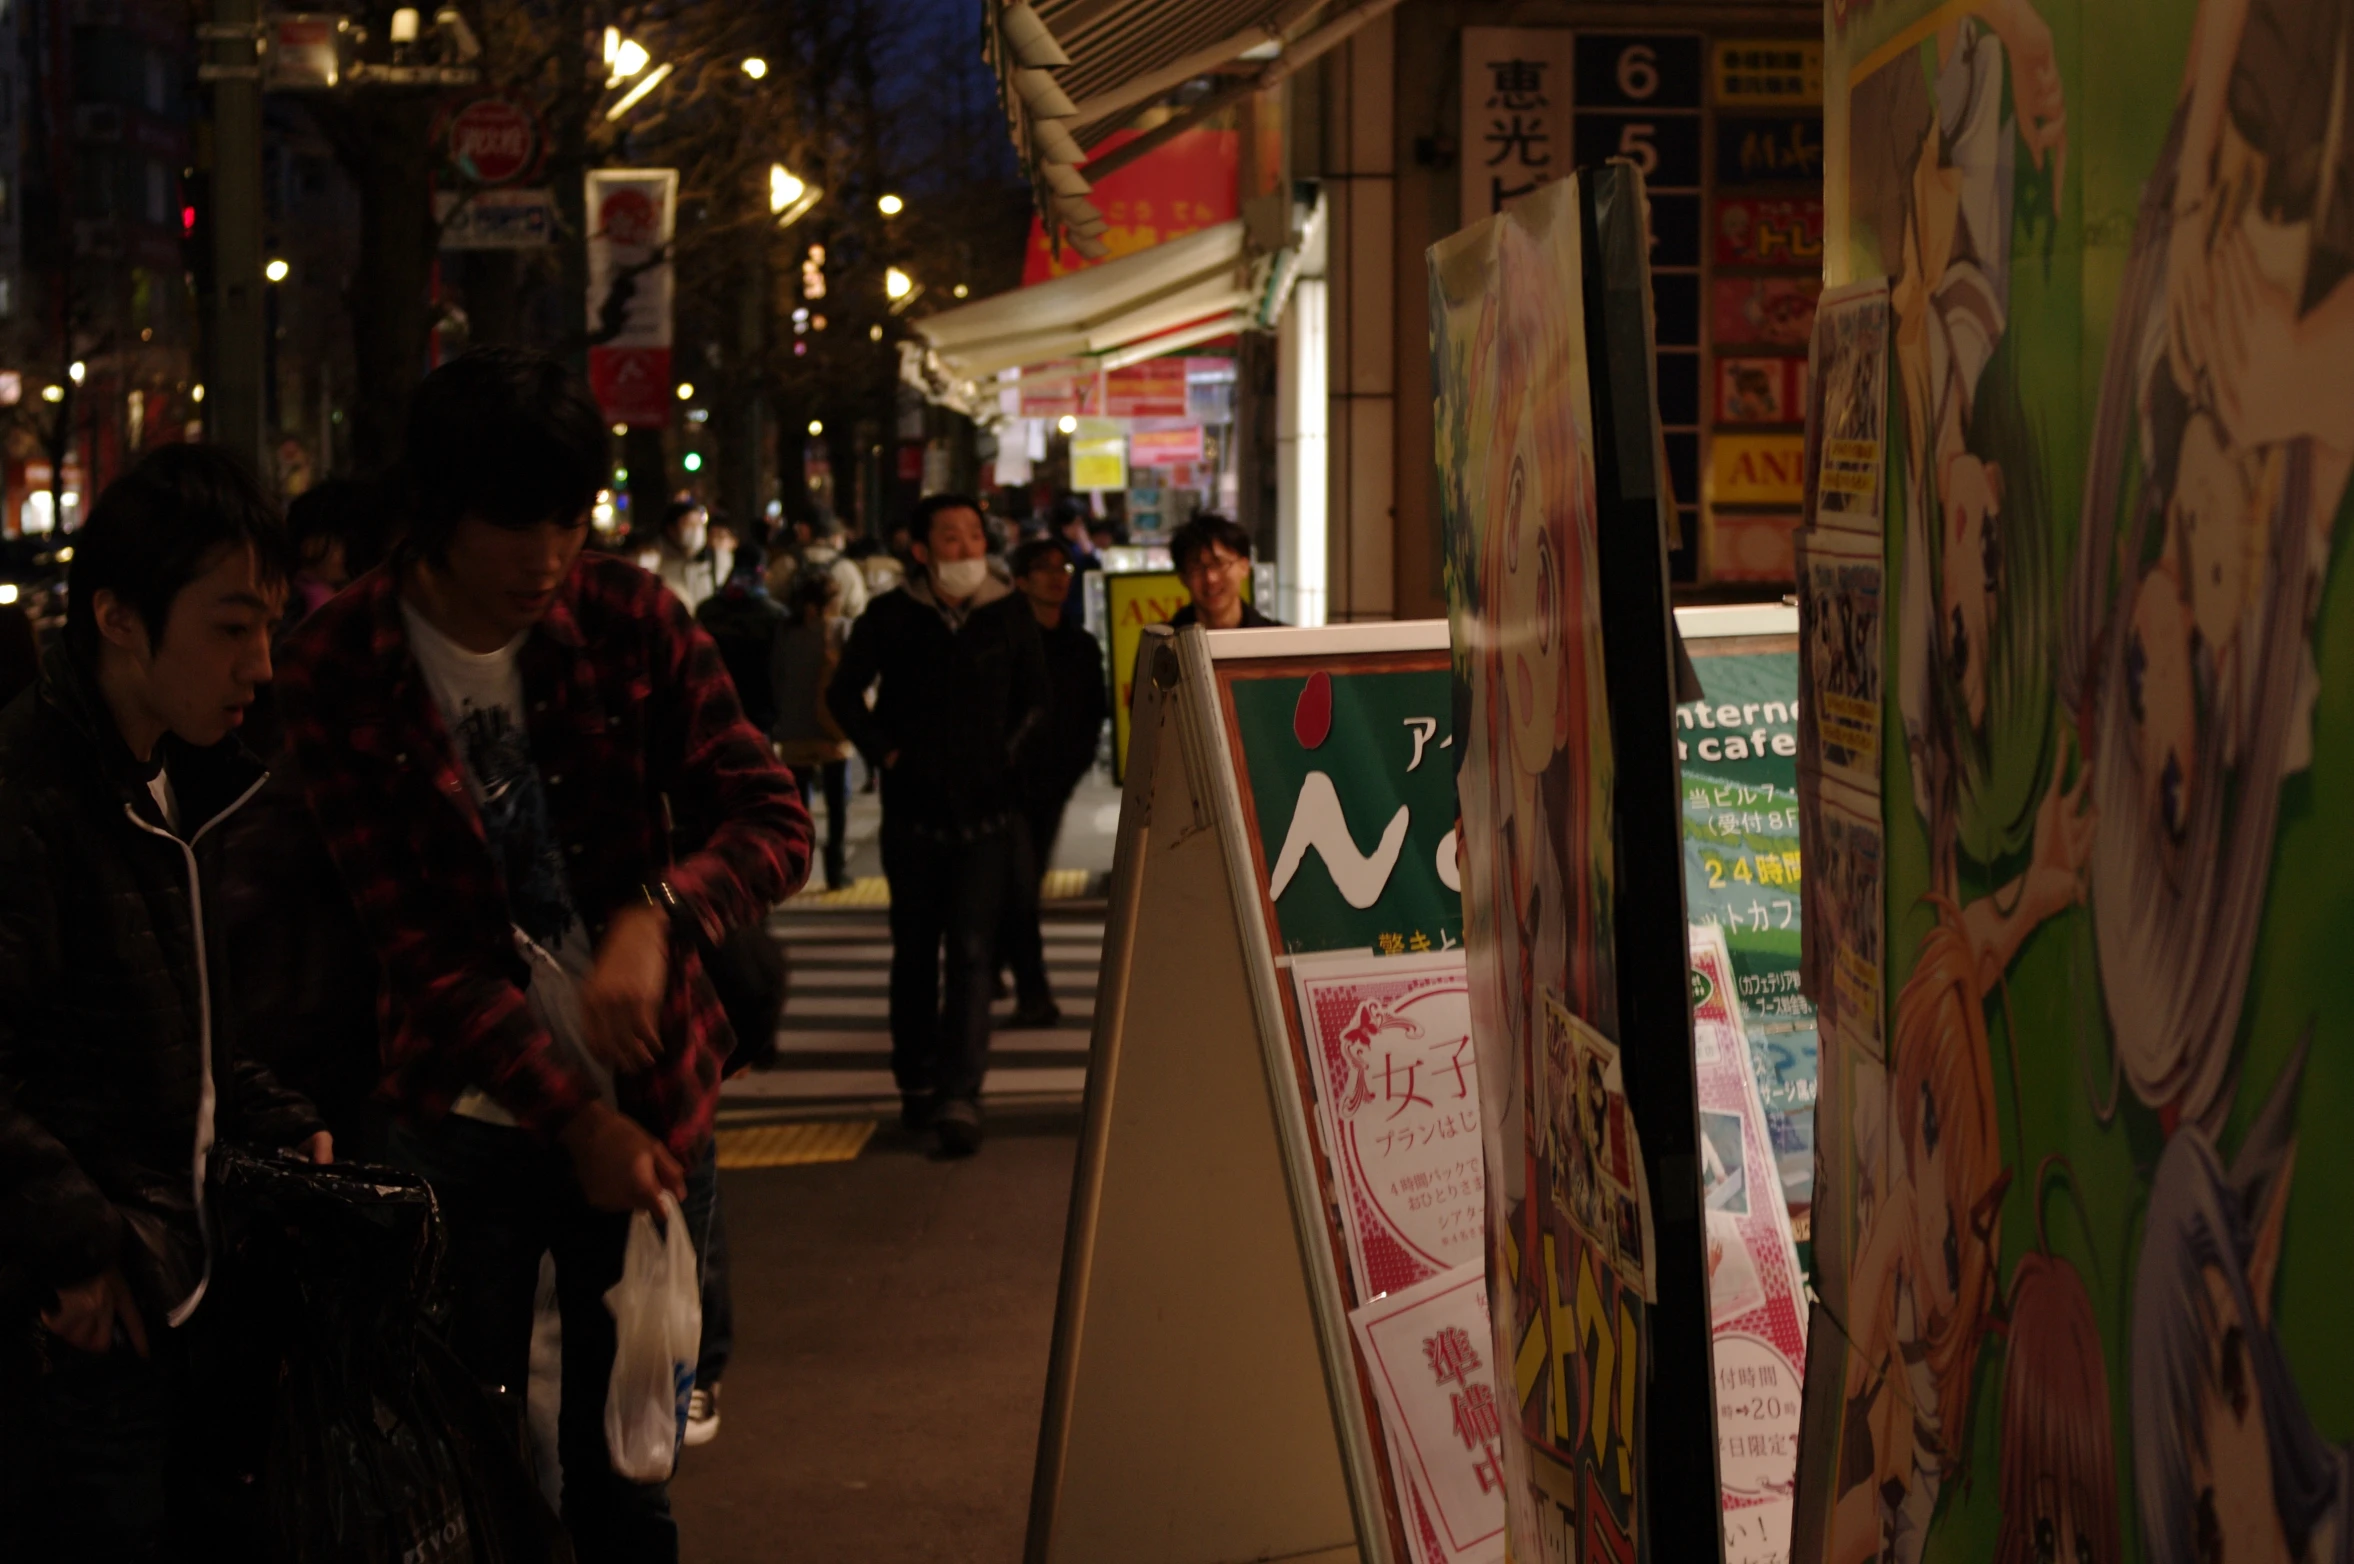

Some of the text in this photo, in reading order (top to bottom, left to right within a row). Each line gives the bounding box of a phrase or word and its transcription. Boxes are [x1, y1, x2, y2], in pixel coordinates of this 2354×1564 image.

[1616, 43, 1660, 100] 6
[1698, 728, 1798, 762] cafe
[1704, 851, 1802, 890] 24時間
[1372, 1035, 1476, 1122] 女子
[1422, 1326, 1506, 1496] 準備中
